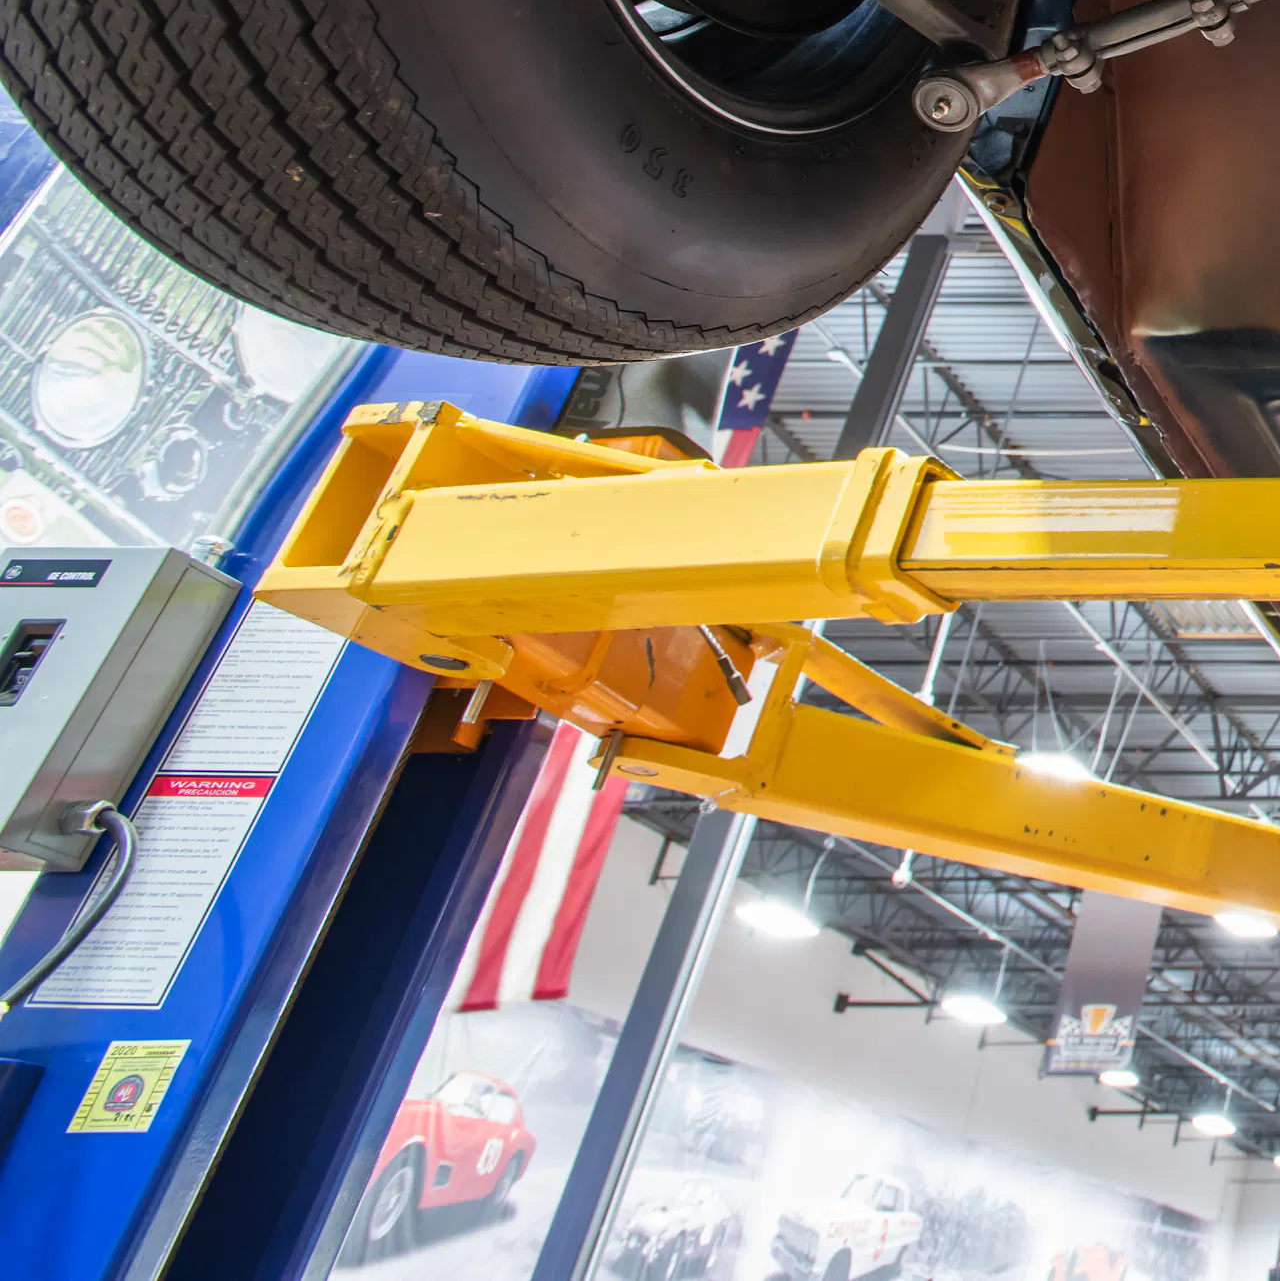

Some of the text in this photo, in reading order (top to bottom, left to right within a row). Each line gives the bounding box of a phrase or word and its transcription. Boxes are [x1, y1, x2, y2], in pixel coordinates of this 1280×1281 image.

[619, 121, 694, 198] 350
[59, 571, 95, 580] CONTROL
[170, 780, 256, 790] WARNING
[111, 1045, 138, 1056] 2020
